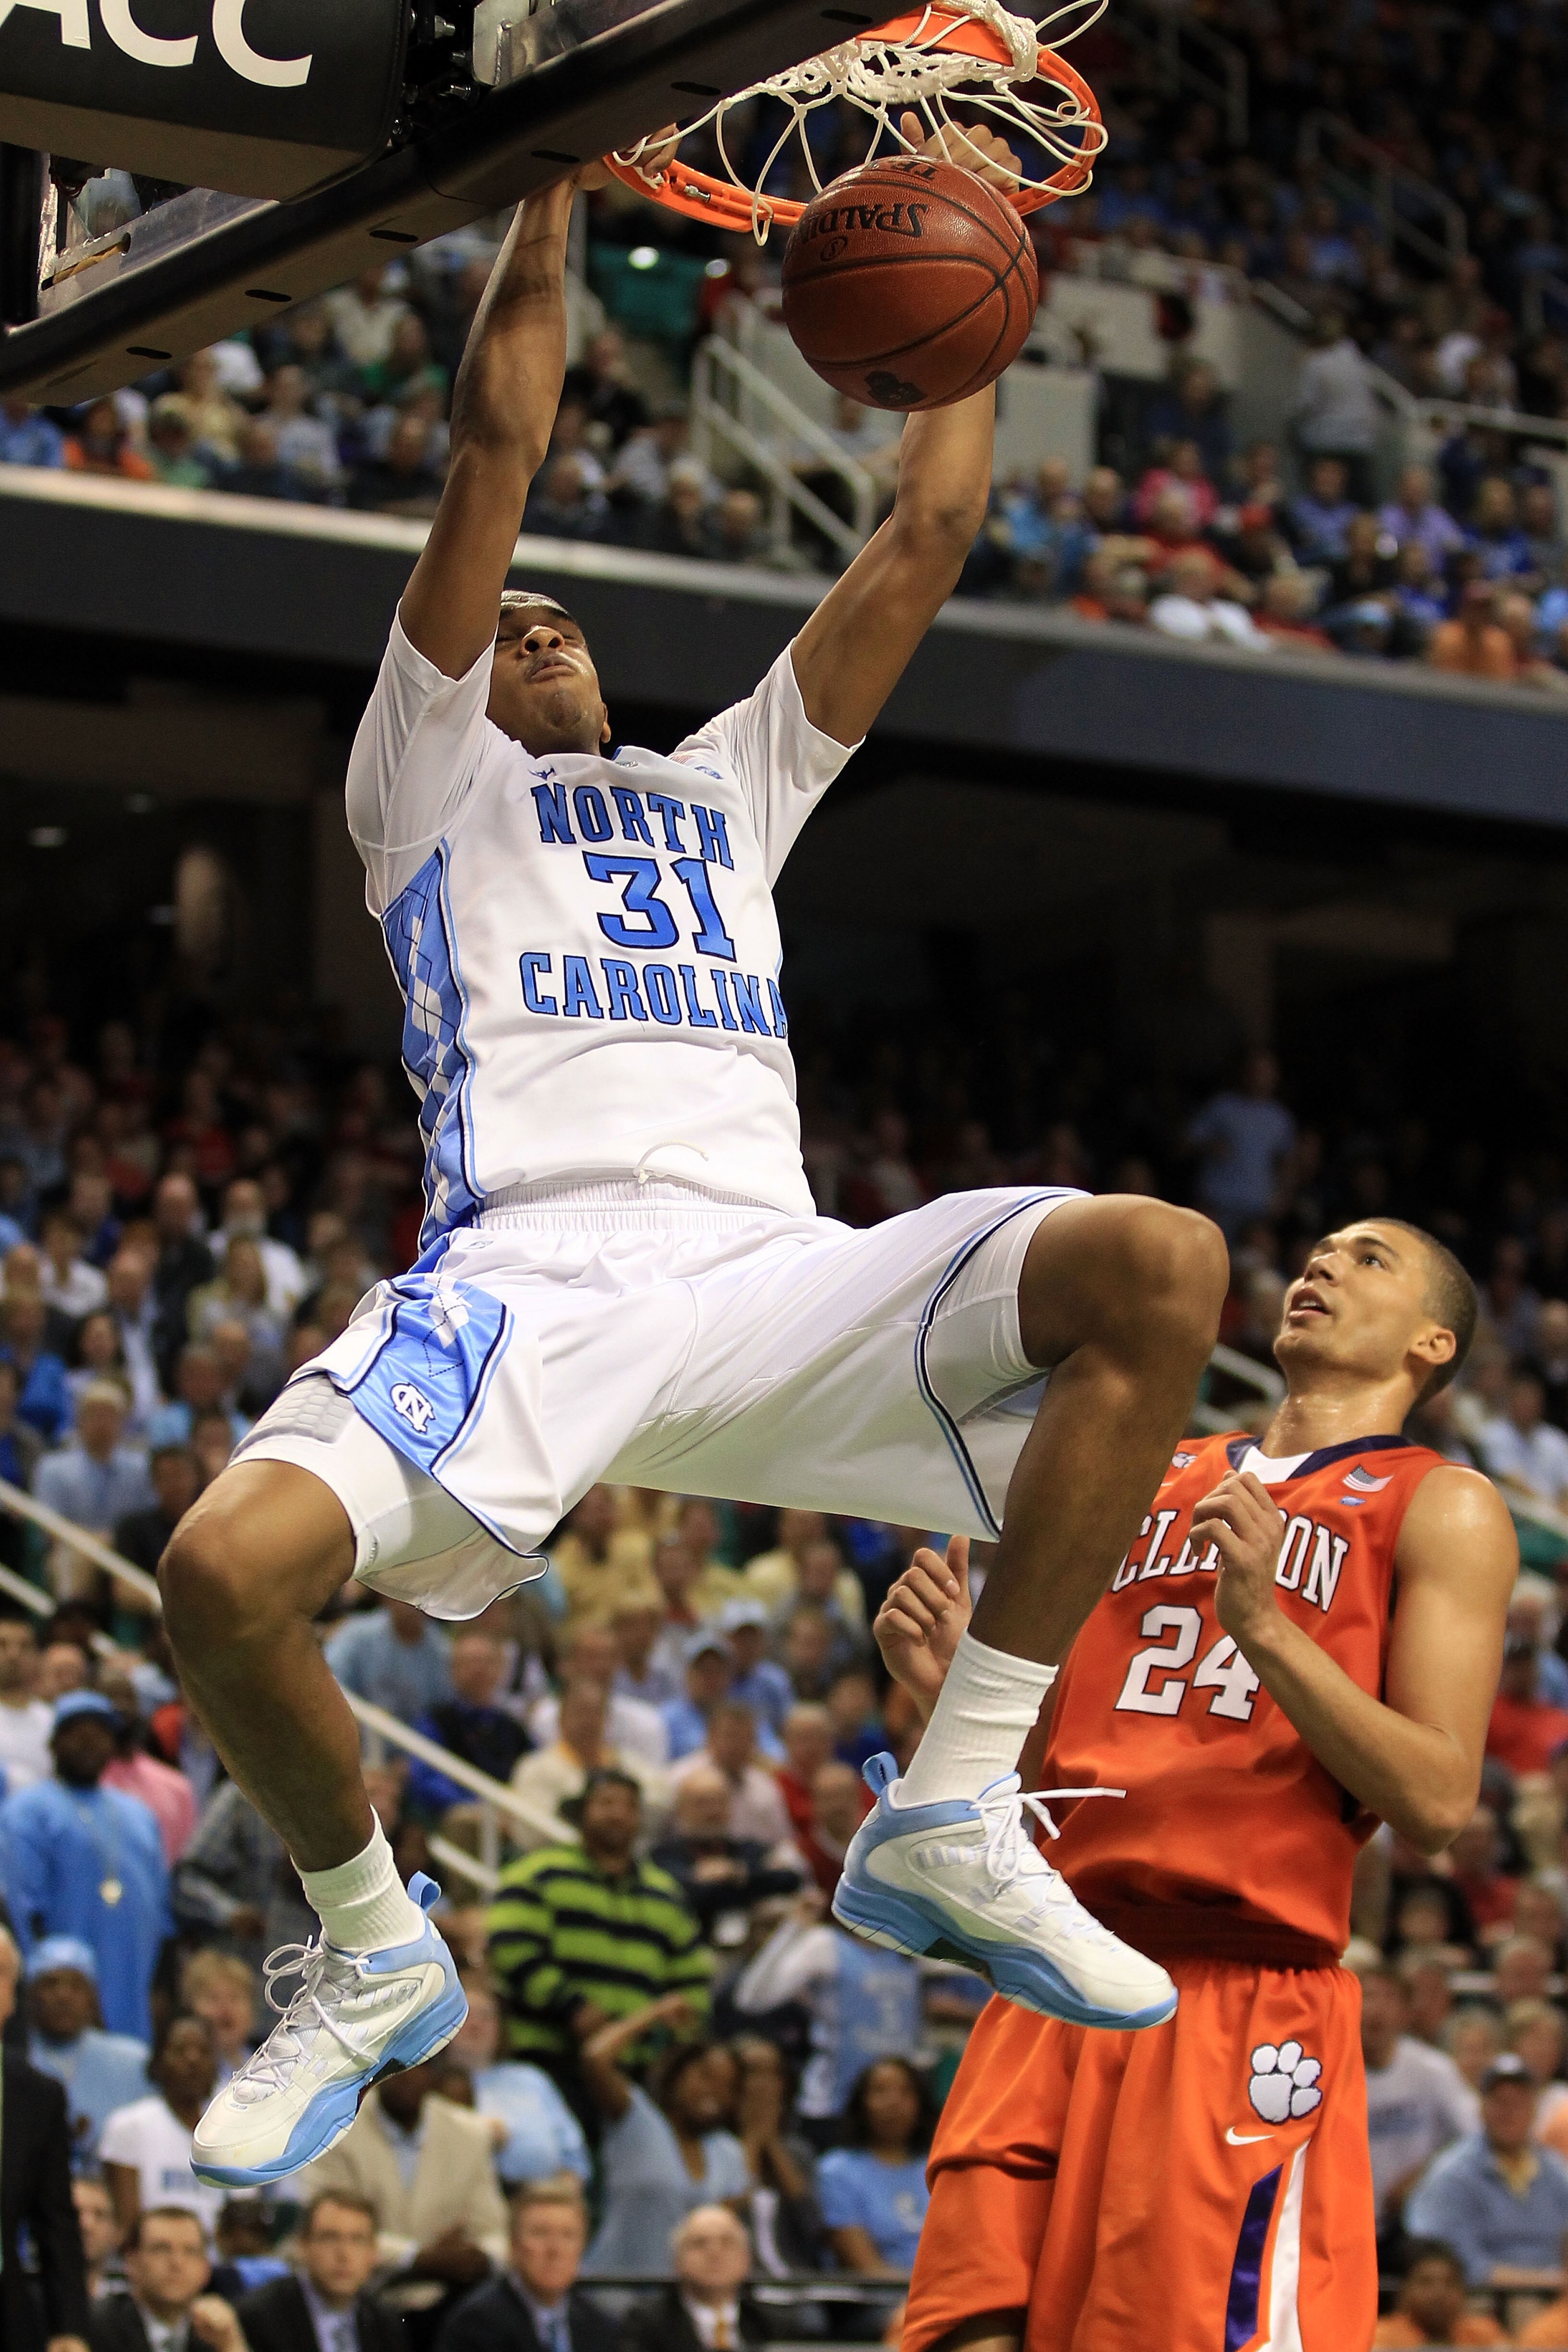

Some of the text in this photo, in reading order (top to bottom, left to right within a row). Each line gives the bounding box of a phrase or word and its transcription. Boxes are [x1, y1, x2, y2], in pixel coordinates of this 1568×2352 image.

[530, 783, 735, 871] NORTH
[582, 850, 737, 963] 31
[519, 952, 788, 1038] CAROLINA
[1110, 1508, 1349, 1612] CLON
[1113, 1605, 1261, 1721] 24
